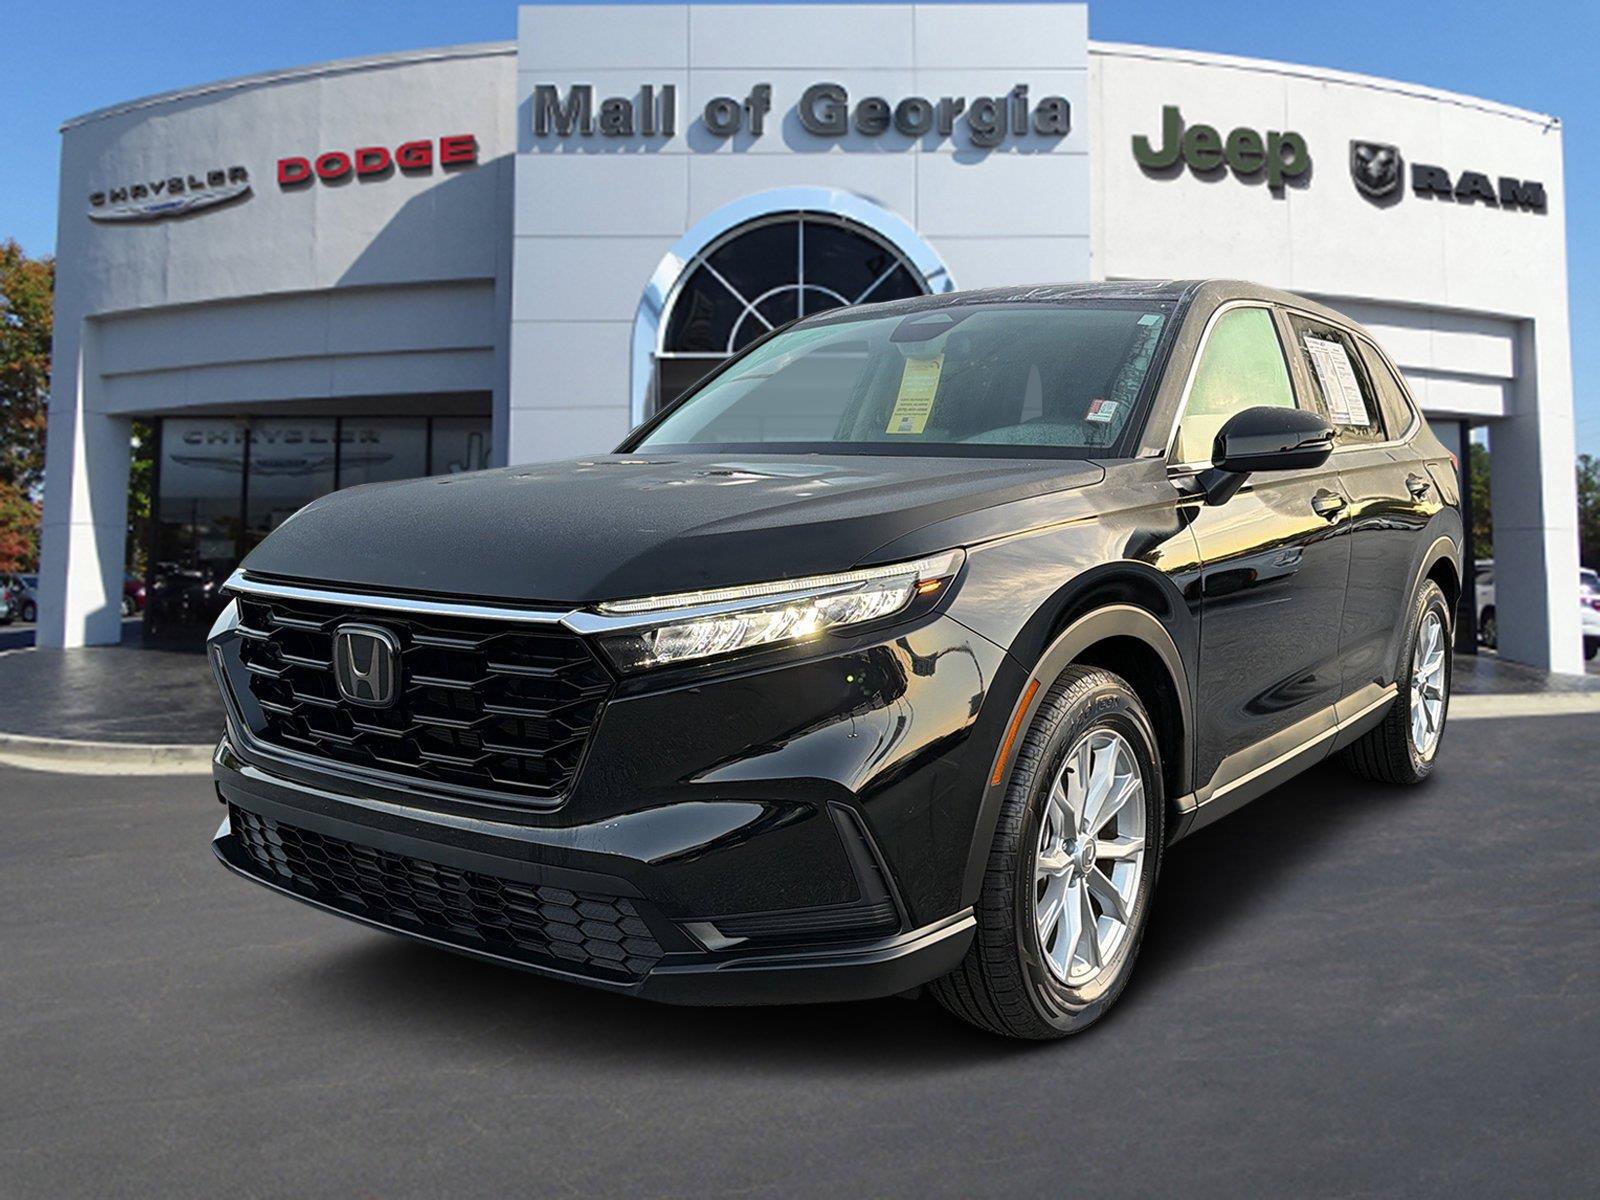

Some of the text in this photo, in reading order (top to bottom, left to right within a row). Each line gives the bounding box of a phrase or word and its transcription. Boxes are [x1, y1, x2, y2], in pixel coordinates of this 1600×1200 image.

[533, 82, 1072, 149] Mall of Georgia
[277, 134, 475, 184] DODGE
[1132, 104, 1309, 187] Jeep
[88, 165, 249, 207] CHRYSLER
[1411, 163, 1544, 209] RAM
[182, 429, 381, 445] CHRYSLER
